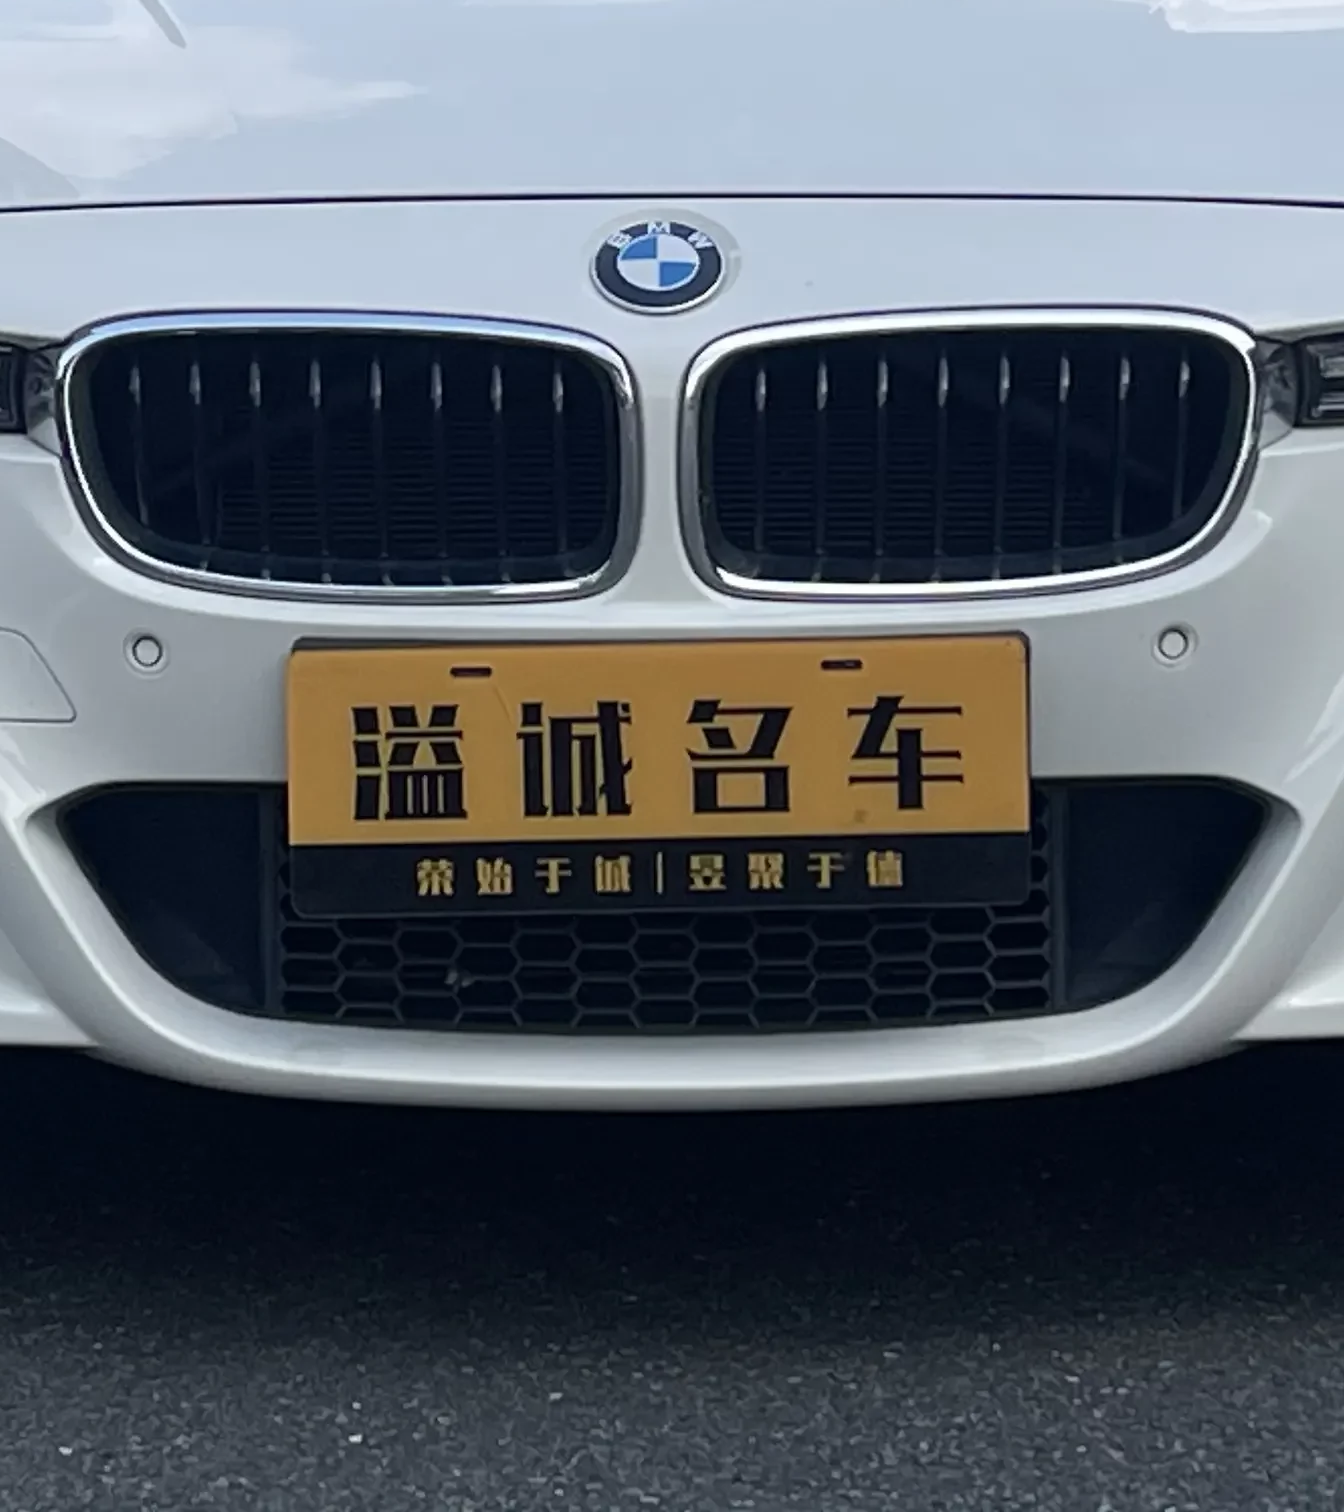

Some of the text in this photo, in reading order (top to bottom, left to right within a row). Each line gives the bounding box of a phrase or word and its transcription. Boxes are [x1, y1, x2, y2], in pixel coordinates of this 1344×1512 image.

[606, 220, 714, 250] BMW
[350, 694, 965, 821] 溢诚名车
